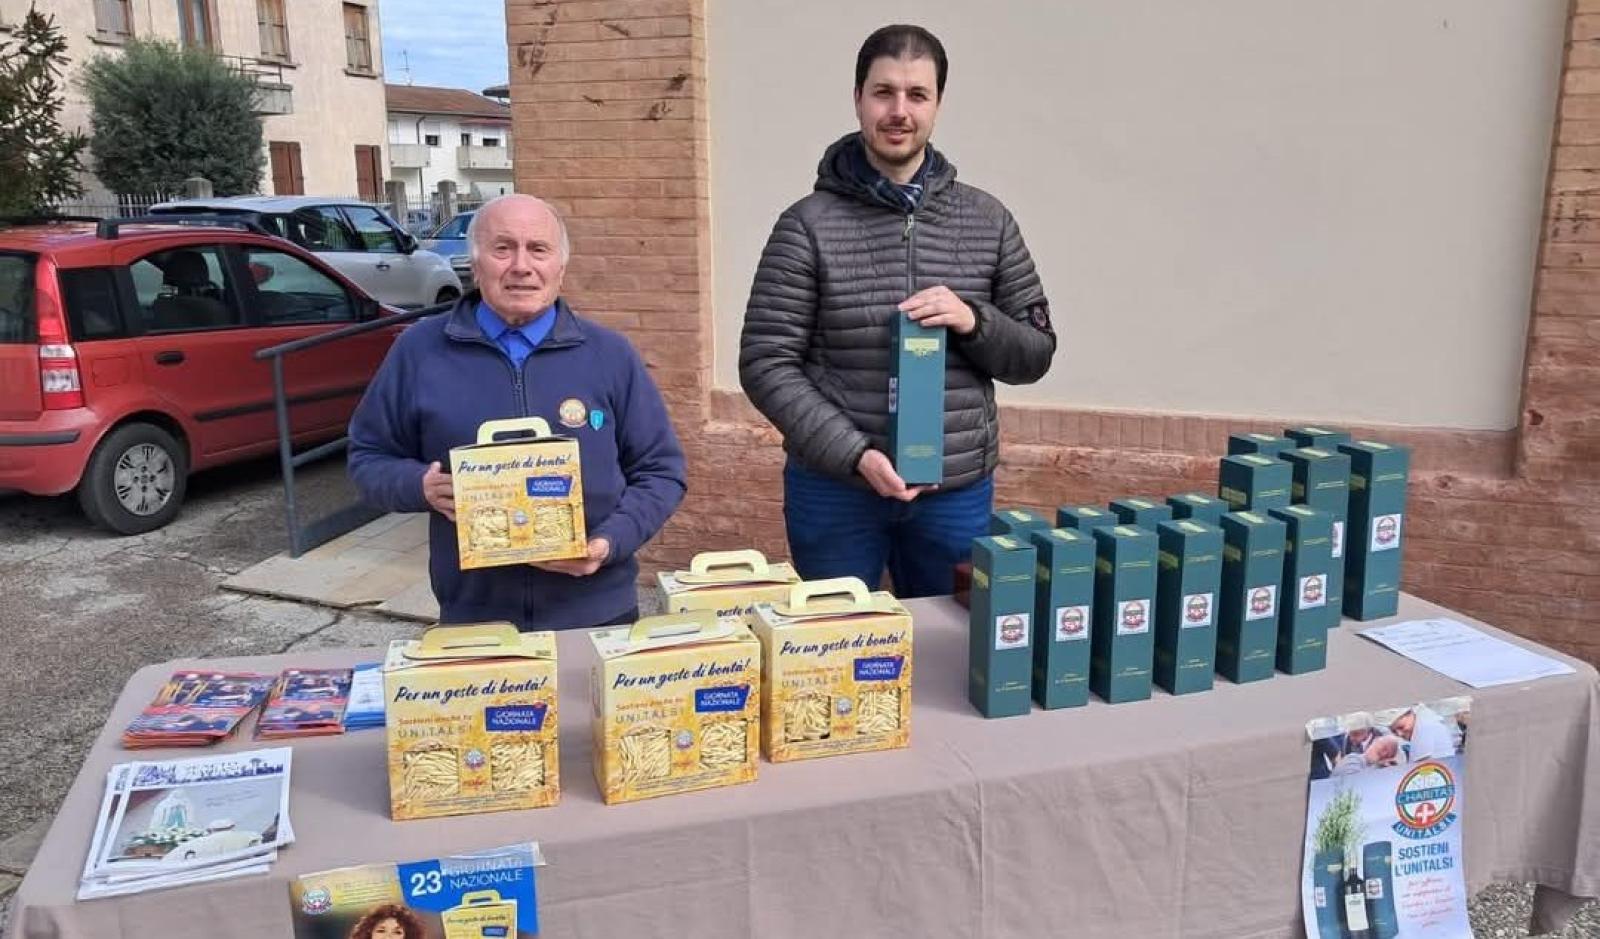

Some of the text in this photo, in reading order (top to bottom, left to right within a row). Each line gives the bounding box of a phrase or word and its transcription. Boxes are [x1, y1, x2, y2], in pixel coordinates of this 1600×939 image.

[458, 461, 475, 474] Per
[478, 462, 493, 472] un
[493, 457, 521, 475] gesto
[523, 457, 535, 468] di
[780, 631, 906, 657] Per un gesto di bontà!
[613, 658, 752, 690] Per un gesto di bontà!
[394, 686, 418, 702] Per
[422, 689, 440, 700] un
[440, 685, 478, 704] gesto
[481, 680, 498, 694] di
[499, 676, 547, 693] bontà!
[703, 691, 739, 700] GIORNATA
[701, 697, 741, 706] NAZIONALE
[491, 717, 536, 725] NAZIONALE
[495, 710, 534, 718] GIORNATA
[398, 723, 472, 738] UNITALSI
[1397, 785, 1455, 804] CHARITAS
[1392, 813, 1457, 839] UNITALSI
[1398, 842, 1449, 860] SOSTIENI
[1395, 859, 1453, 878] L'UNITALSI
[450, 869, 523, 889] NAZIONALE
